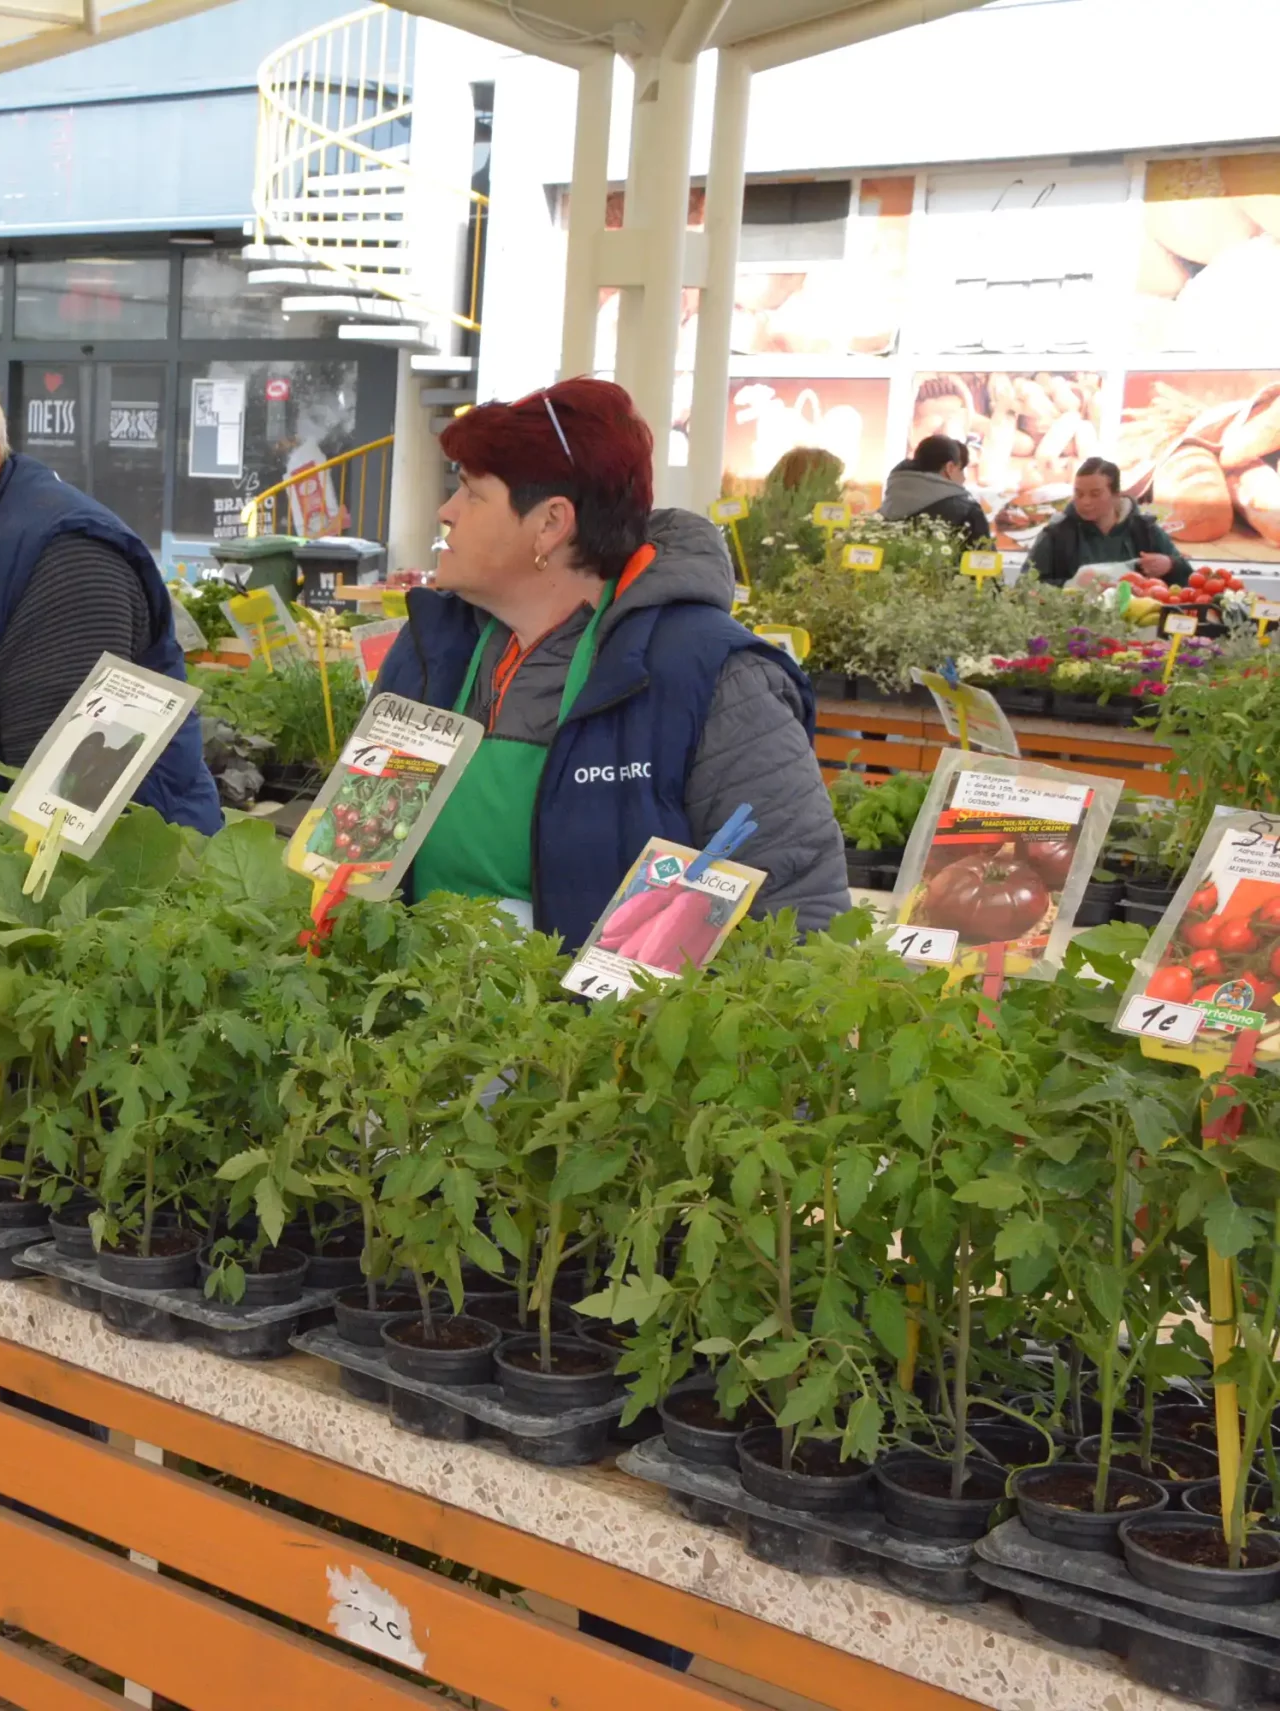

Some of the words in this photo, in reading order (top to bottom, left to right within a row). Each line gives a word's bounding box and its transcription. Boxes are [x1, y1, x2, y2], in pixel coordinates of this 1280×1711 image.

[214, 493, 275, 513] BRAO
[574, 766, 615, 784] OPG
[38, 801, 78, 827] CLASIC
[695, 874, 737, 895] AJČICA
